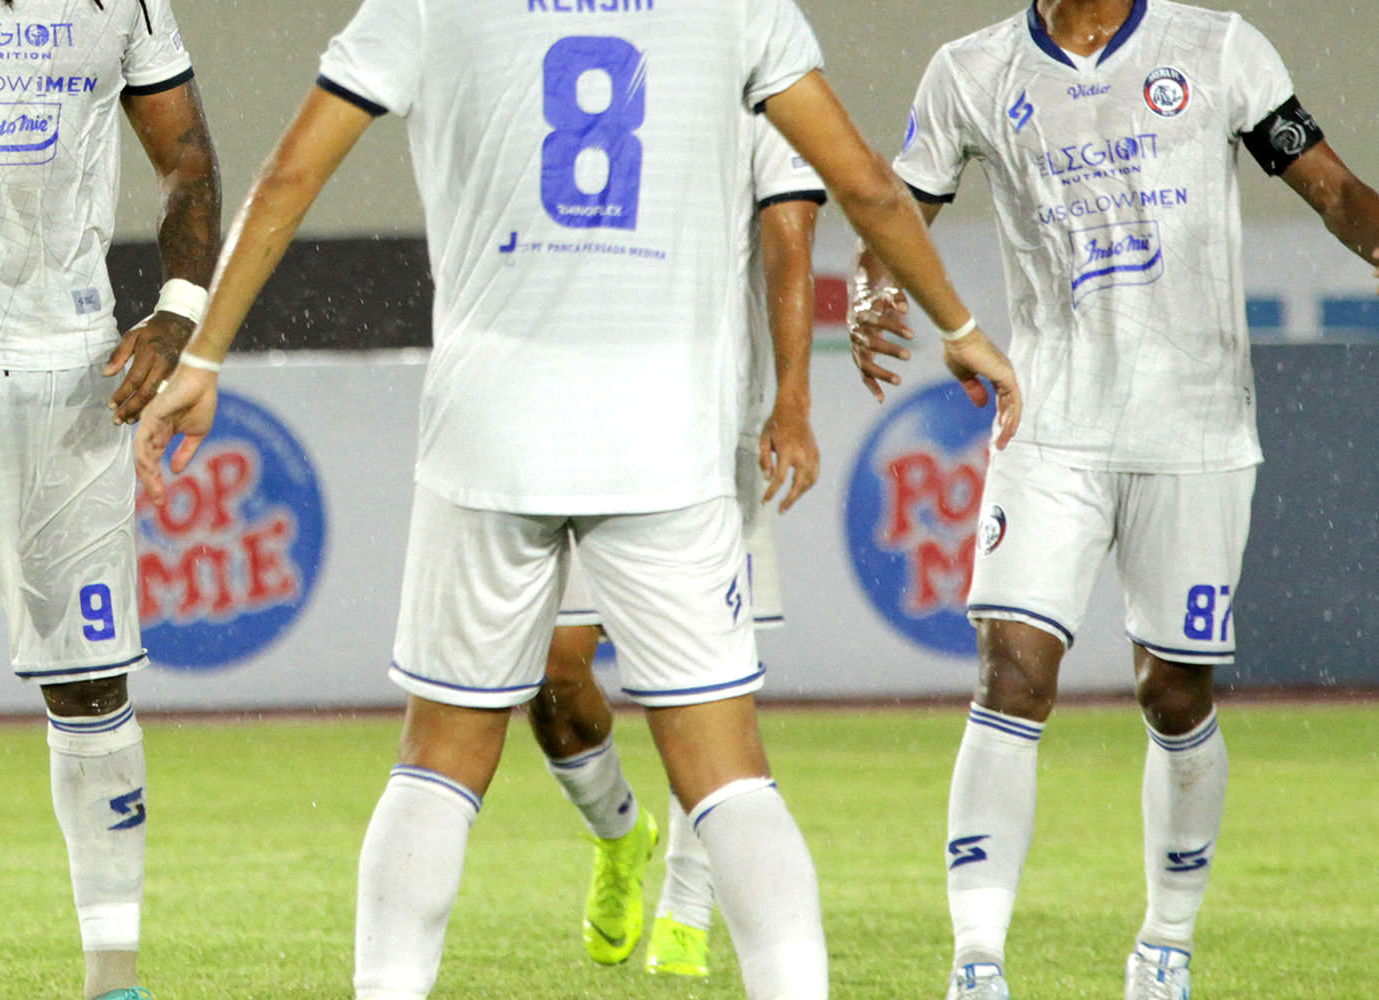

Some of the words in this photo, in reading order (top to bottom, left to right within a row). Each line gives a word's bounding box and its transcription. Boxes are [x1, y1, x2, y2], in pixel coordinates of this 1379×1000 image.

[45, 76, 99, 93] MEN
[1066, 82, 1111, 100] Vidio
[539, 35, 647, 231] 8
[1061, 164, 1142, 186] NUTRITION
[1140, 187, 1188, 207] MEN
[886, 448, 990, 544] PO
[78, 583, 116, 642] 9
